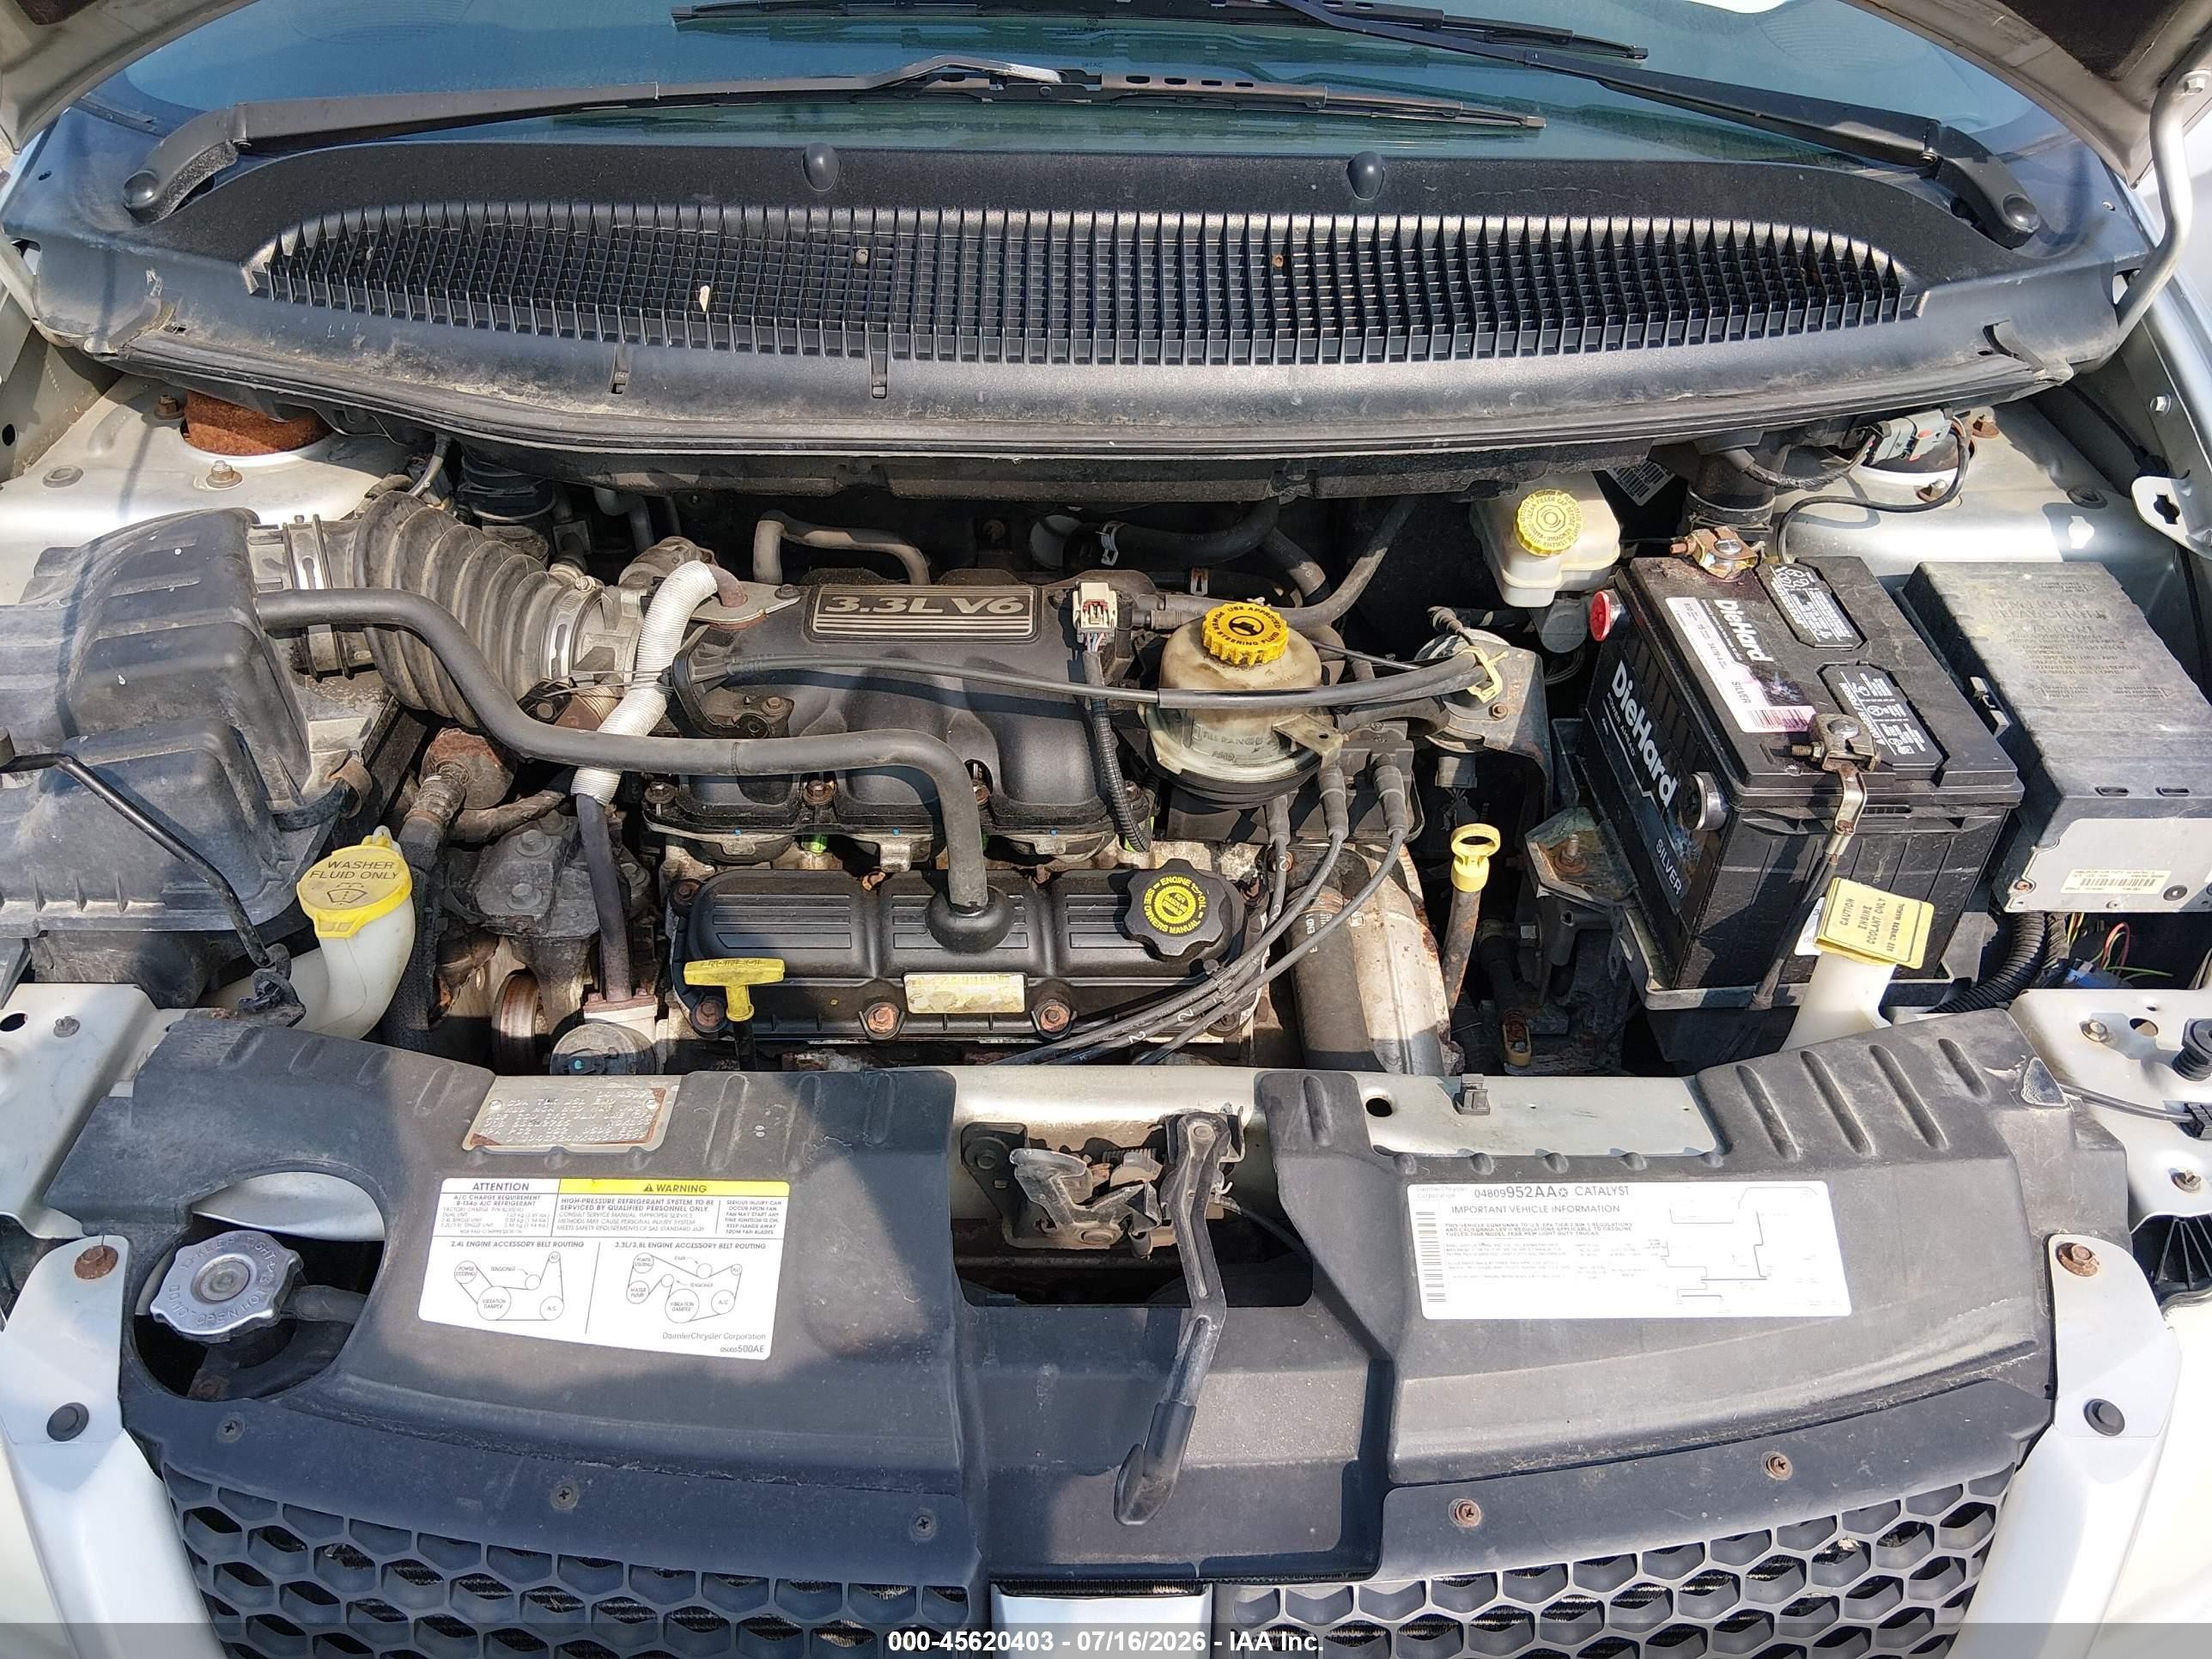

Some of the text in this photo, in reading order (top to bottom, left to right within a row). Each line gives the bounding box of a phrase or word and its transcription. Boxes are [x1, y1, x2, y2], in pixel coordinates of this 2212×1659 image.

[824, 597, 1024, 613] 3.3L V6
[1248, 606, 1281, 629] APPROVED
[1212, 611, 1279, 646] POWER STEERING FLUID
[1713, 599, 1774, 662] DieHard
[1731, 681, 1751, 703] SILVER
[1838, 683, 1860, 706] POISON
[1607, 692, 1635, 757] POWER AHEAD
[1612, 659, 1678, 808] DieHard
[309, 871, 399, 879] FLUID ONLY
[328, 860, 395, 869] WASHER
[1656, 838, 1682, 895] SILVER
[1144, 889, 1155, 905] SEE
[1160, 876, 1206, 909] ENGINE OIL
[1144, 905, 1168, 932] OWNERS
[1839, 897, 1856, 926] CAUTION
[1857, 905, 1872, 930] ENGINE
[1867, 897, 1887, 945] COOLANT ONLY
[1169, 919, 1200, 934] MANUAL
[1177, 1009, 1194, 1022] 2
[1128, 1030, 1146, 1043] 2
[472, 1182, 529, 1191] ATTENTION
[656, 1184, 707, 1193] WARNING
[1474, 1186, 1629, 1198] 04809952AA CATALYST
[1509, 1205, 1549, 1213] VEHICLE
[198, 1237, 236, 1257] KEEP
[724, 1332, 766, 1340] Corporation
